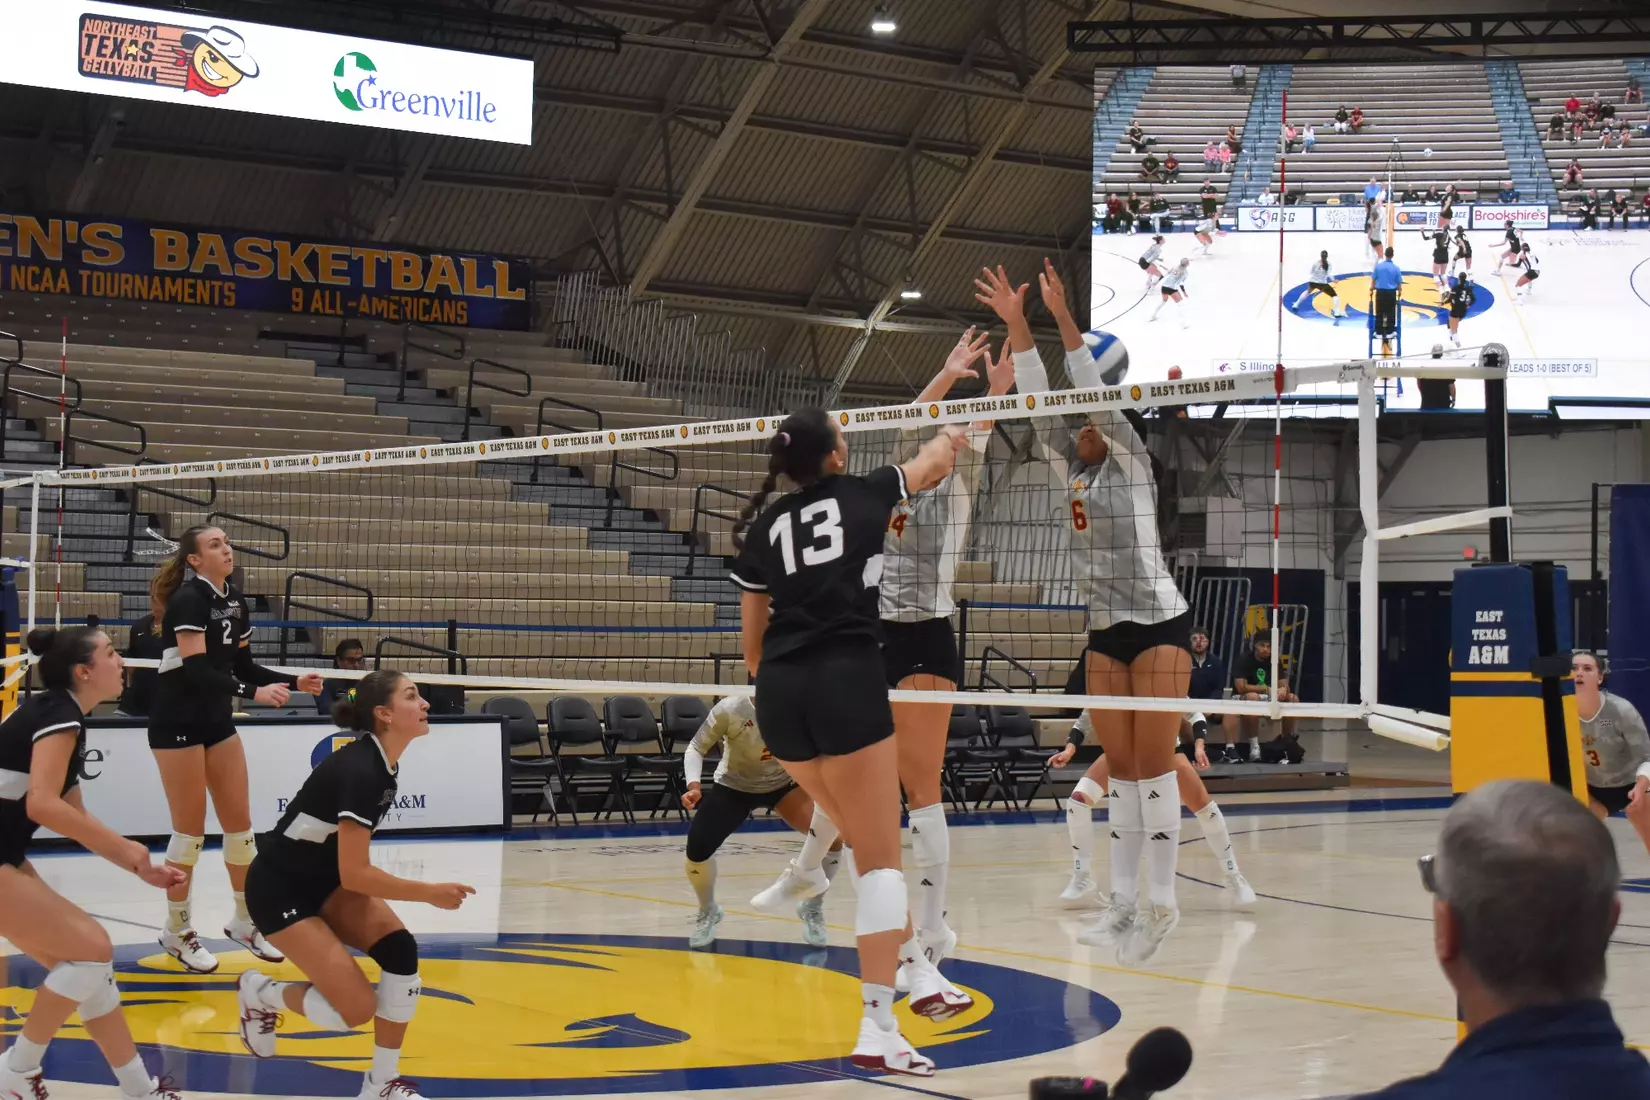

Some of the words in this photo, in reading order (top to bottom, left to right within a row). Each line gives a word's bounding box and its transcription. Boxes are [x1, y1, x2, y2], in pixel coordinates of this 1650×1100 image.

[84, 18, 156, 40] NORTHEAST
[84, 34, 154, 63] TEXAS
[82, 58, 155, 80] GELLYBALL
[356, 77, 496, 122] Greenville
[150, 228, 526, 300] BASKETBALL
[11, 264, 70, 294] NCAA
[79, 270, 236, 307] TOURNAMENTS
[291, 287, 303, 312] 9
[1240, 362, 1246, 370] S
[1536, 364, 1547, 372] 1-0
[1548, 364, 1570, 374] (BEST
[1572, 364, 1583, 372] OF
[1584, 364, 1592, 374] 5)
[1151, 385, 1175, 397] EAST
[1177, 381, 1211, 394] TEXAS
[1214, 379, 1235, 391] A&M
[946, 404, 967, 415] EAST
[969, 401, 997, 413] TEXAS
[999, 399, 1018, 410] A&M
[1044, 394, 1067, 407] EAST
[1070, 392, 1100, 405] TEXAS
[1102, 390, 1122, 402] A&M
[855, 413, 875, 423] EAST
[877, 410, 903, 420] TEXAS
[904, 408, 923, 418] A&M
[693, 426, 710, 435] EAST
[712, 424, 735, 434] TEXAS
[1071, 500, 1088, 532] 6
[768, 498, 844, 576] 13
[1475, 610, 1504, 622] EAST
[222, 618, 232, 644] 2
[1472, 628, 1506, 640] TEXAS
[1468, 645, 1509, 664] A&M
